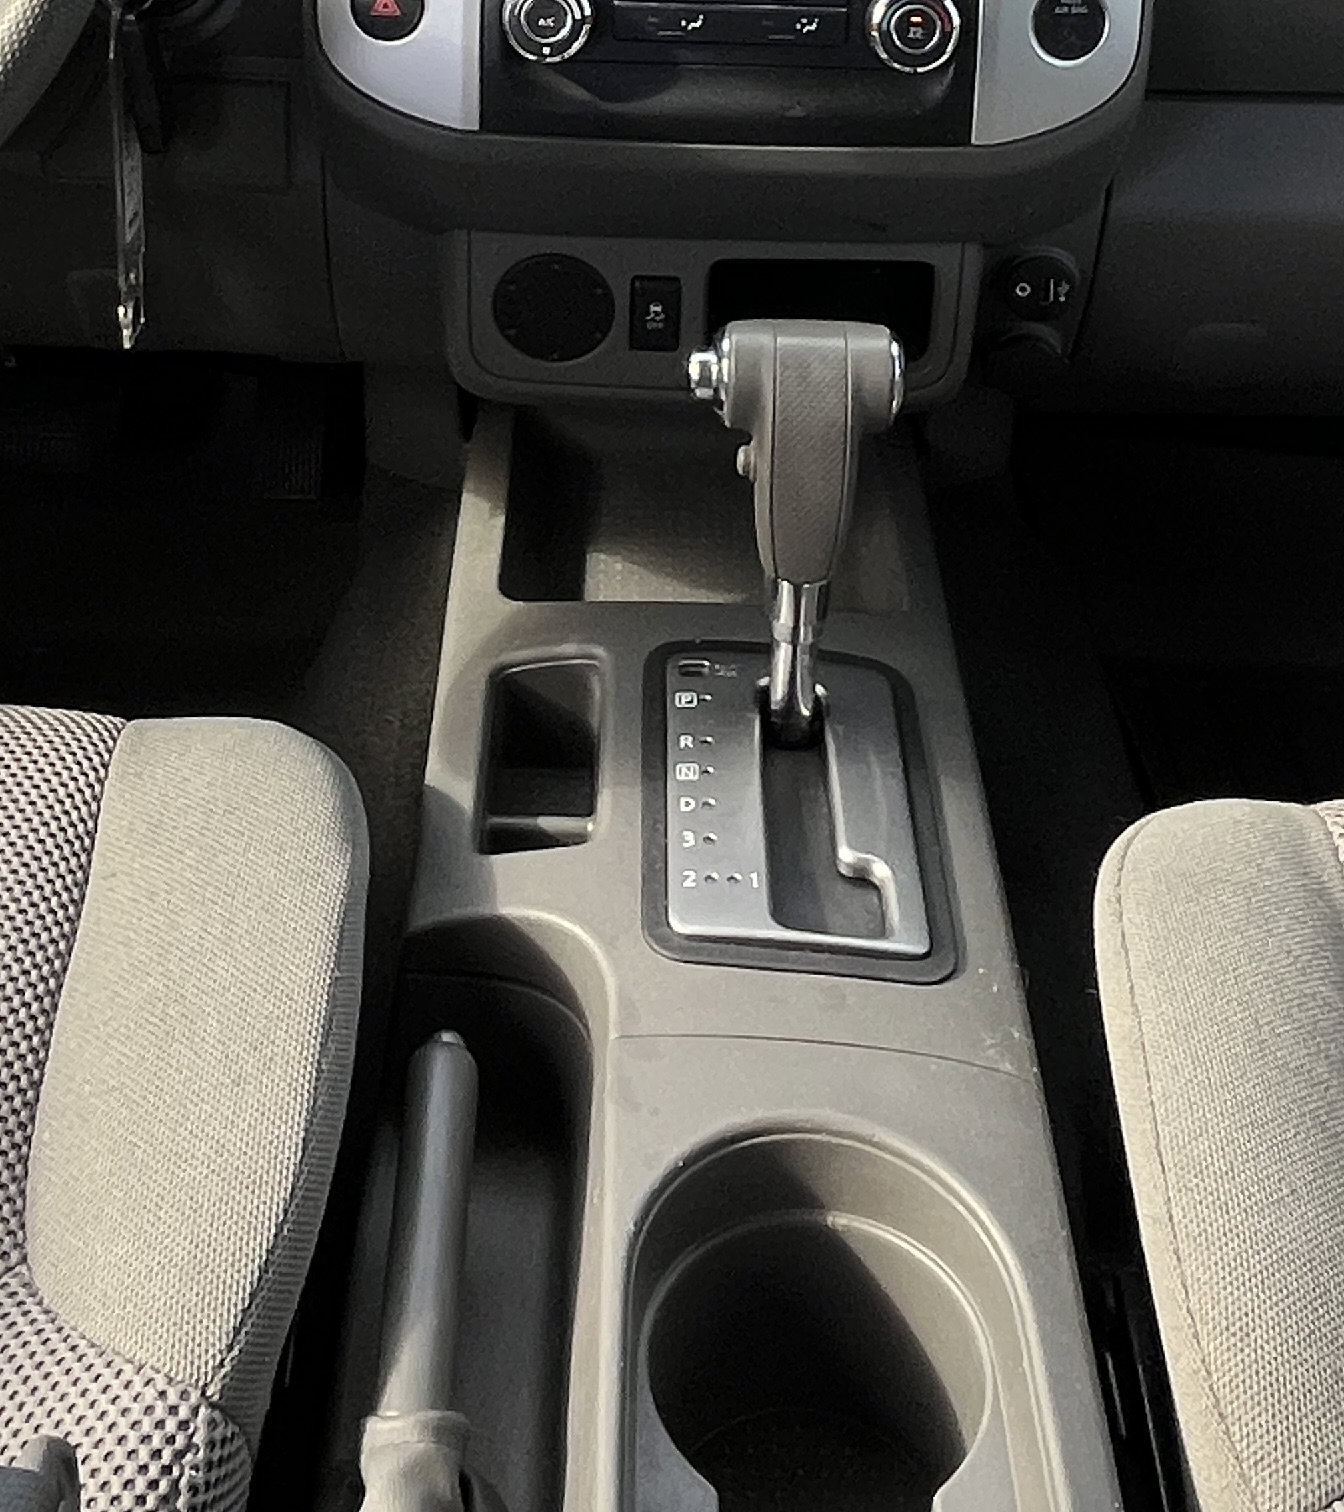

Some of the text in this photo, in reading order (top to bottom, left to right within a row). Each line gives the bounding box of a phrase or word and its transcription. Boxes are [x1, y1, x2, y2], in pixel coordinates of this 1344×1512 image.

[679, 734, 694, 749] R
[680, 798, 696, 812] D
[682, 830, 696, 848] 3
[682, 870, 760, 888] 2 1
